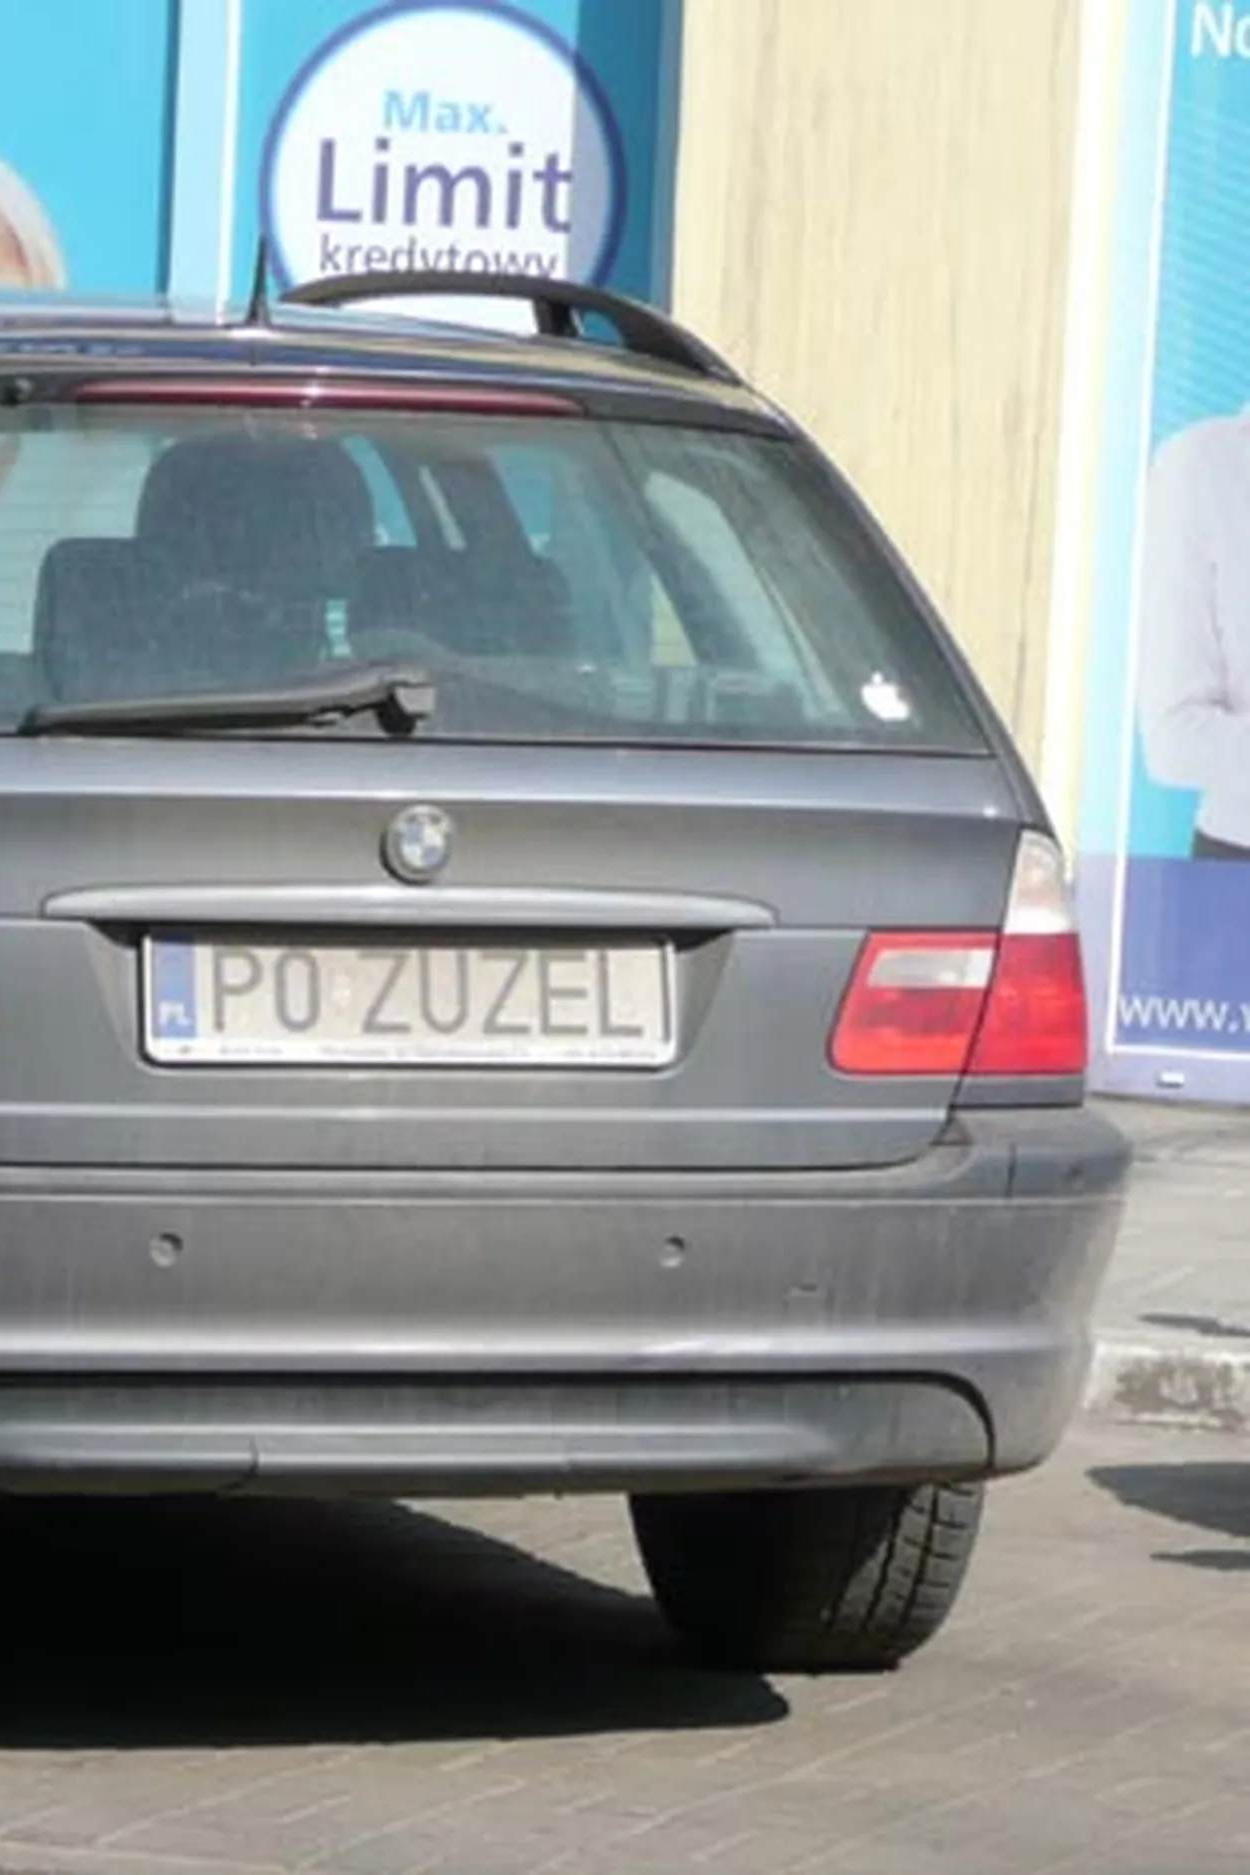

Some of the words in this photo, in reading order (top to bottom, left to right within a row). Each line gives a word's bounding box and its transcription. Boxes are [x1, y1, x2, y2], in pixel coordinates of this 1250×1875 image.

[383, 90, 509, 135] Max.
[316, 136, 574, 234] Limit
[355, 948, 644, 1038] ZUZEL
